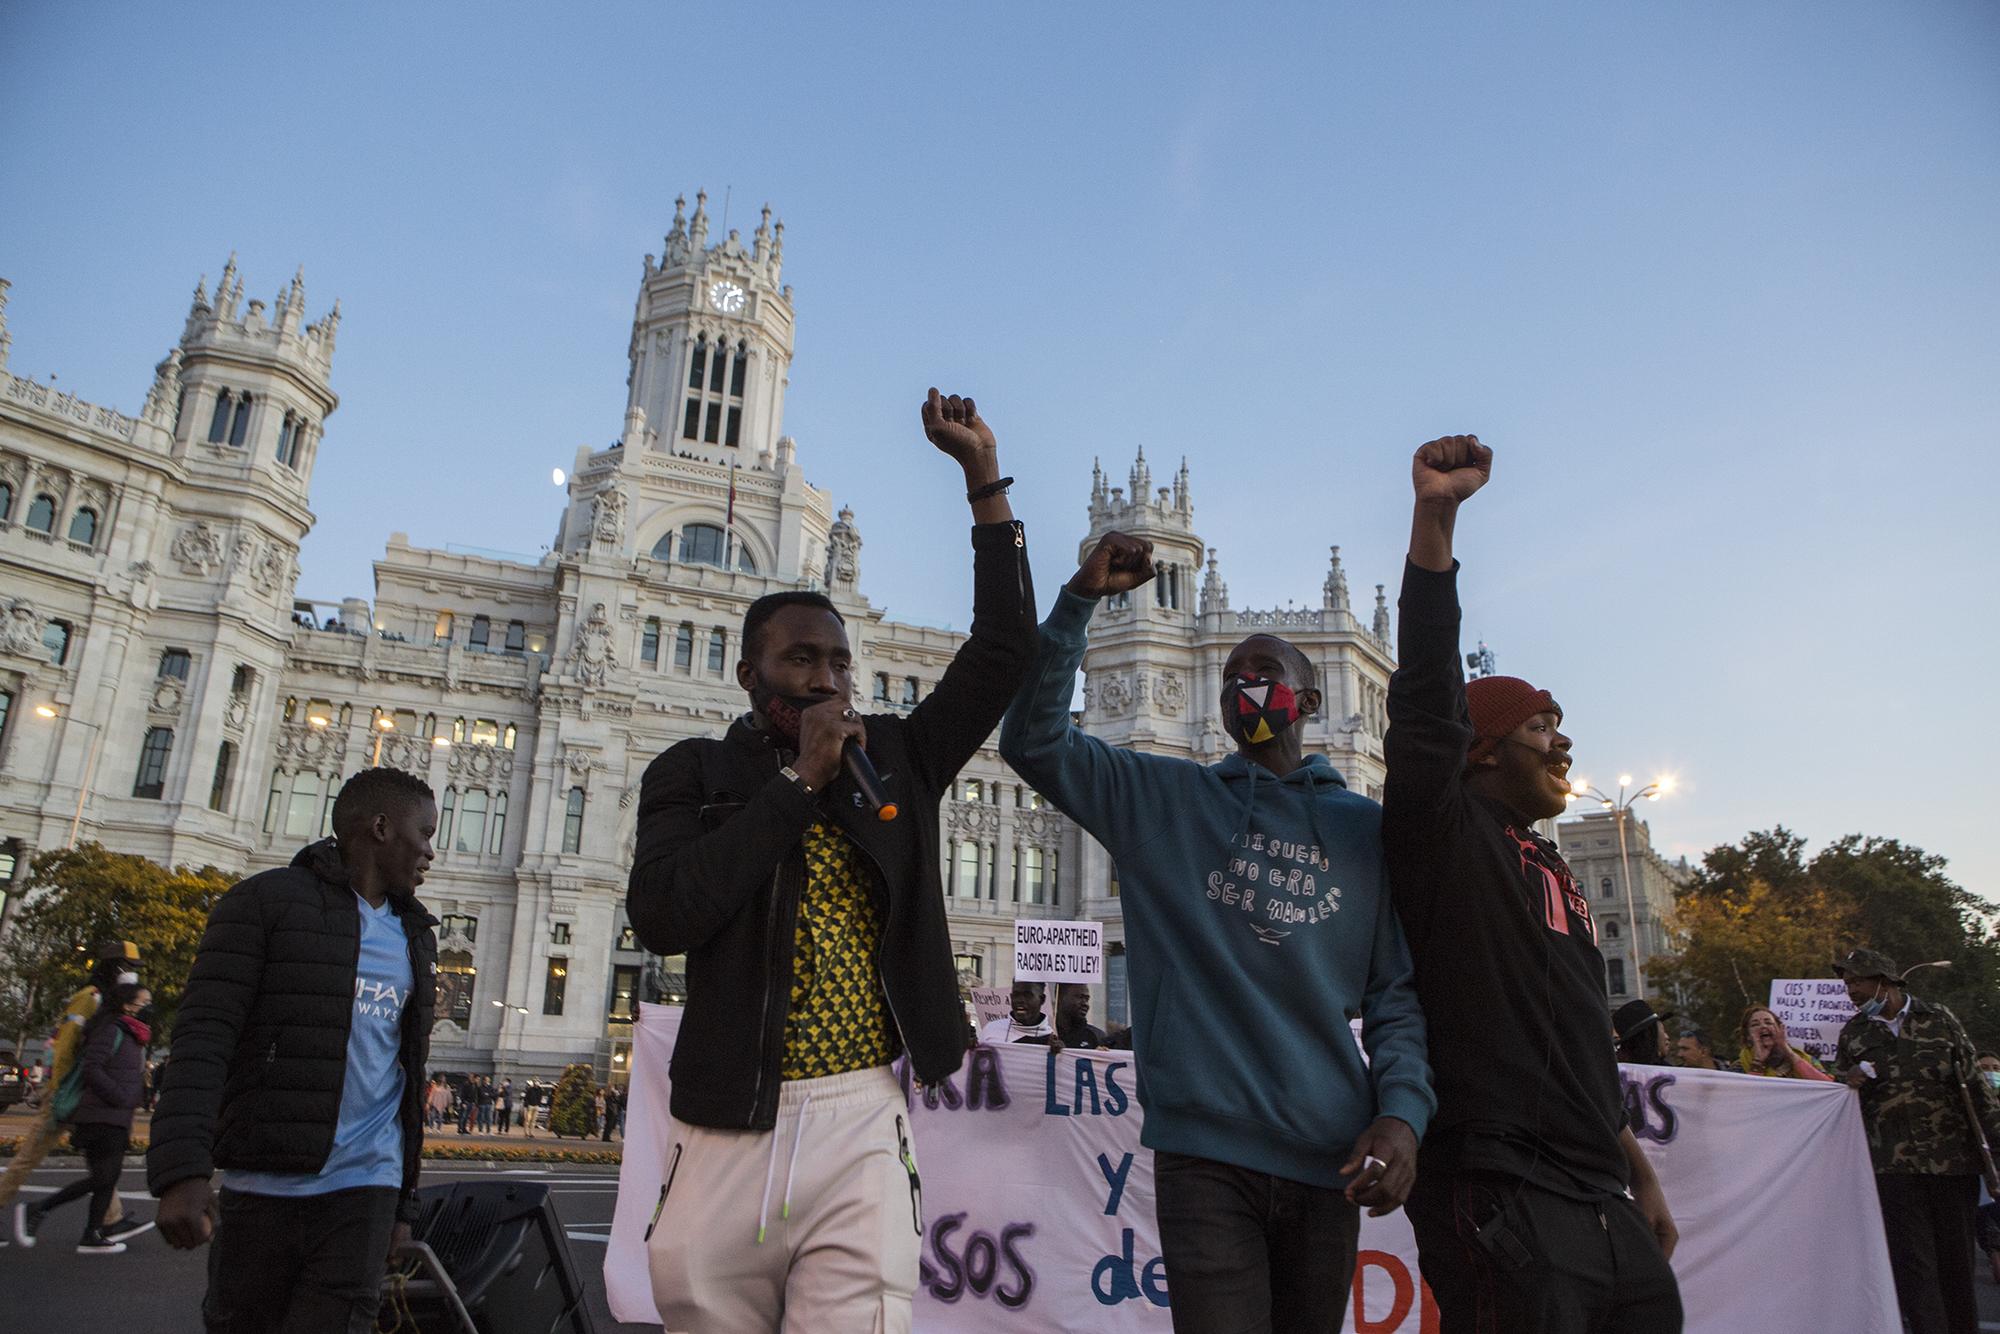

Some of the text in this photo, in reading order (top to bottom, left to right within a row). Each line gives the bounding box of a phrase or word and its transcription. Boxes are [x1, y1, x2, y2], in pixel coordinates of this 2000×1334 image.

[1206, 871, 1255, 912] SER
[1229, 857, 1316, 896] NO ERA
[1017, 952, 1100, 974] RACISTA ES TU LEY!
[1776, 997, 1806, 1009] VALLAS
[1818, 1000, 1856, 1012] FRONTERA
[1815, 983, 1847, 996] REDADA
[1800, 1012, 1811, 1022] SE
[1813, 1013, 1852, 1024] CONSTRU
[1045, 1052, 1128, 1117] LAS
[1097, 1151, 1135, 1216] Y
[919, 1212, 1038, 1312] SOS
[1091, 1228, 1171, 1308] de
